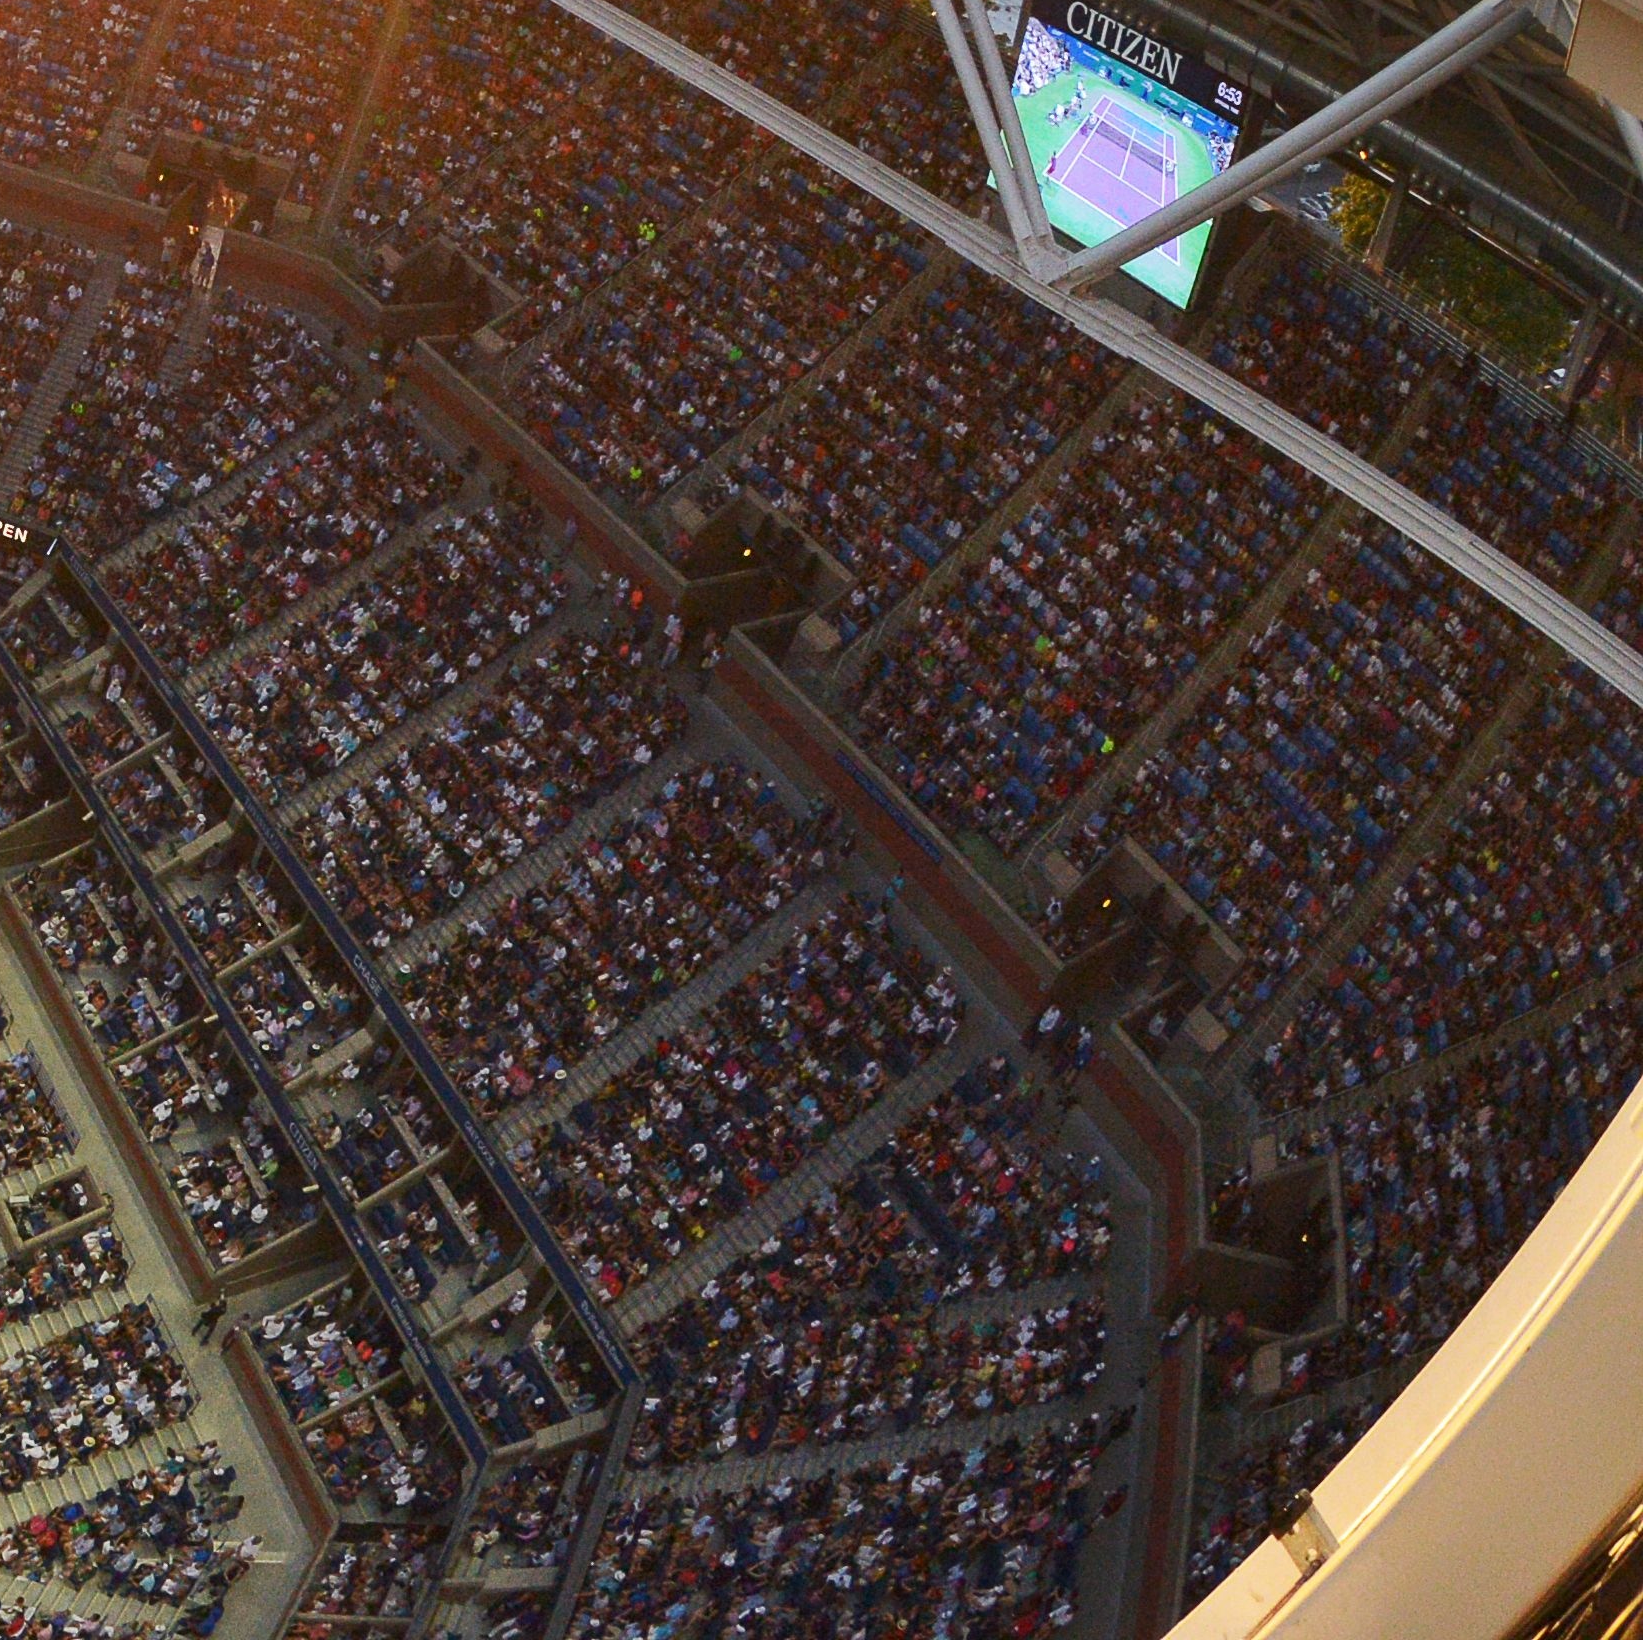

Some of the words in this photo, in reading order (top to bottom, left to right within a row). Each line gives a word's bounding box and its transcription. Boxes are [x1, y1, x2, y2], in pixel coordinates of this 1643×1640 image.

[1066, 0, 1183, 86] CITIZEN
[1217, 81, 1243, 106] 6:53
[352, 954, 382, 997] CHASE
[289, 1121, 319, 1170] CITIZEN
